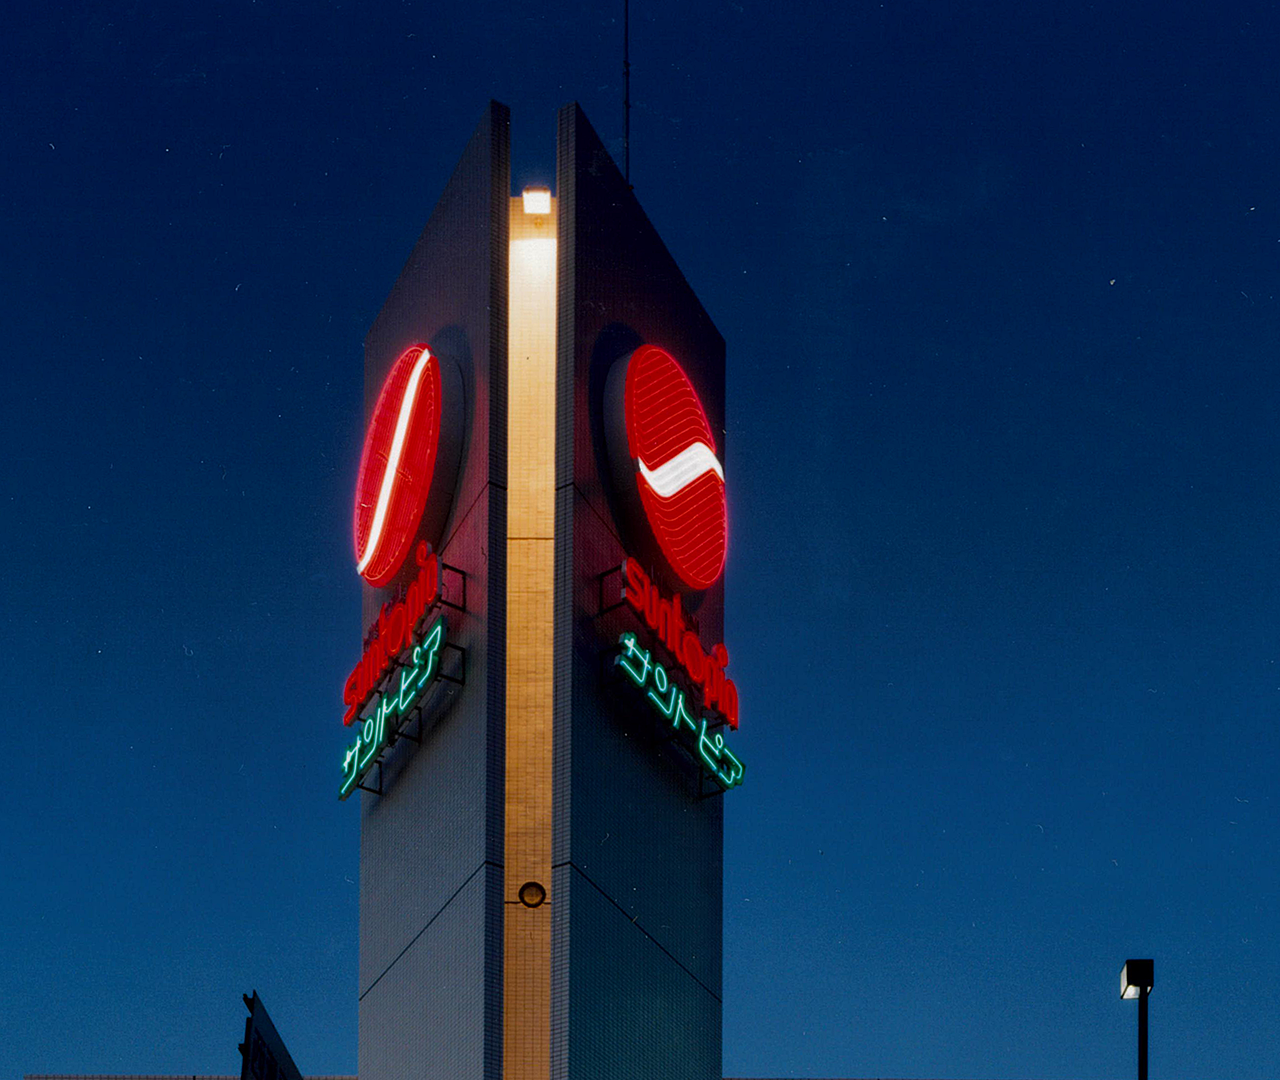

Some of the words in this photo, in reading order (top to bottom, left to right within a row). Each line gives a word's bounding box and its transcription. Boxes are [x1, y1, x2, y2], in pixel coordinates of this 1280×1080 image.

[339, 617, 447, 800] サントピア
[342, 540, 442, 727] suntopia
[617, 632, 746, 788] サントピア
[623, 556, 739, 730] suntopia
